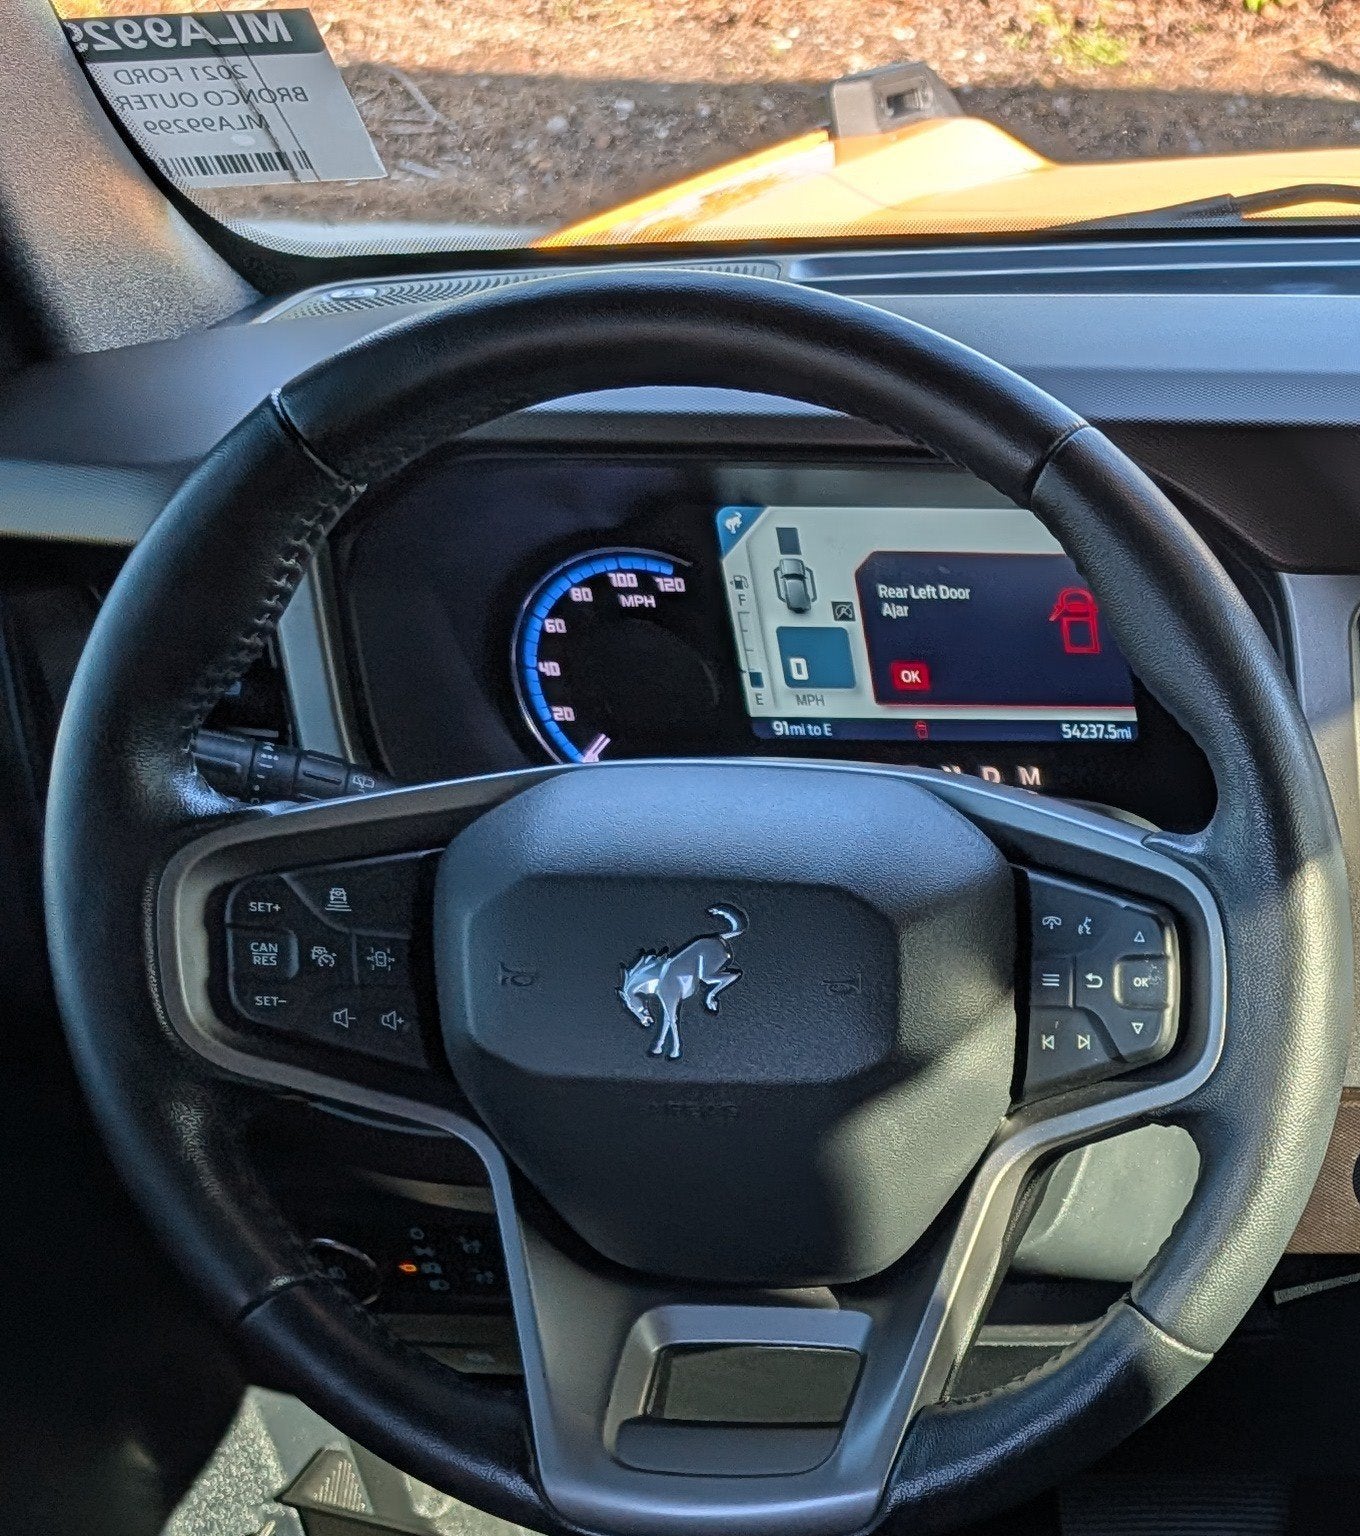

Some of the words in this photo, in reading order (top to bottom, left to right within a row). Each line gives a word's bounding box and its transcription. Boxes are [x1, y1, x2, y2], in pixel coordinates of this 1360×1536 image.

[607, 573, 639, 588] 100
[654, 576, 686, 593] 120
[570, 587, 594, 602] 80
[876, 583, 908, 600] Rear
[910, 584, 937, 600] Left
[939, 584, 971, 601] Door
[618, 594, 657, 608] MPH
[738, 594, 747, 606] F
[881, 602, 910, 619] Ajar
[544, 618, 568, 634] 60
[537, 661, 562, 677] 40
[900, 669, 922, 684] OK
[755, 694, 764, 705] E
[795, 693, 826, 707] MPH
[551, 706, 576, 722] 20
[807, 722, 822, 736] to
[824, 723, 833, 737] E
[1016, 765, 1043, 787] M
[250, 942, 278, 953] CAN
[253, 955, 277, 966] RES
[1133, 977, 1149, 988] OK
